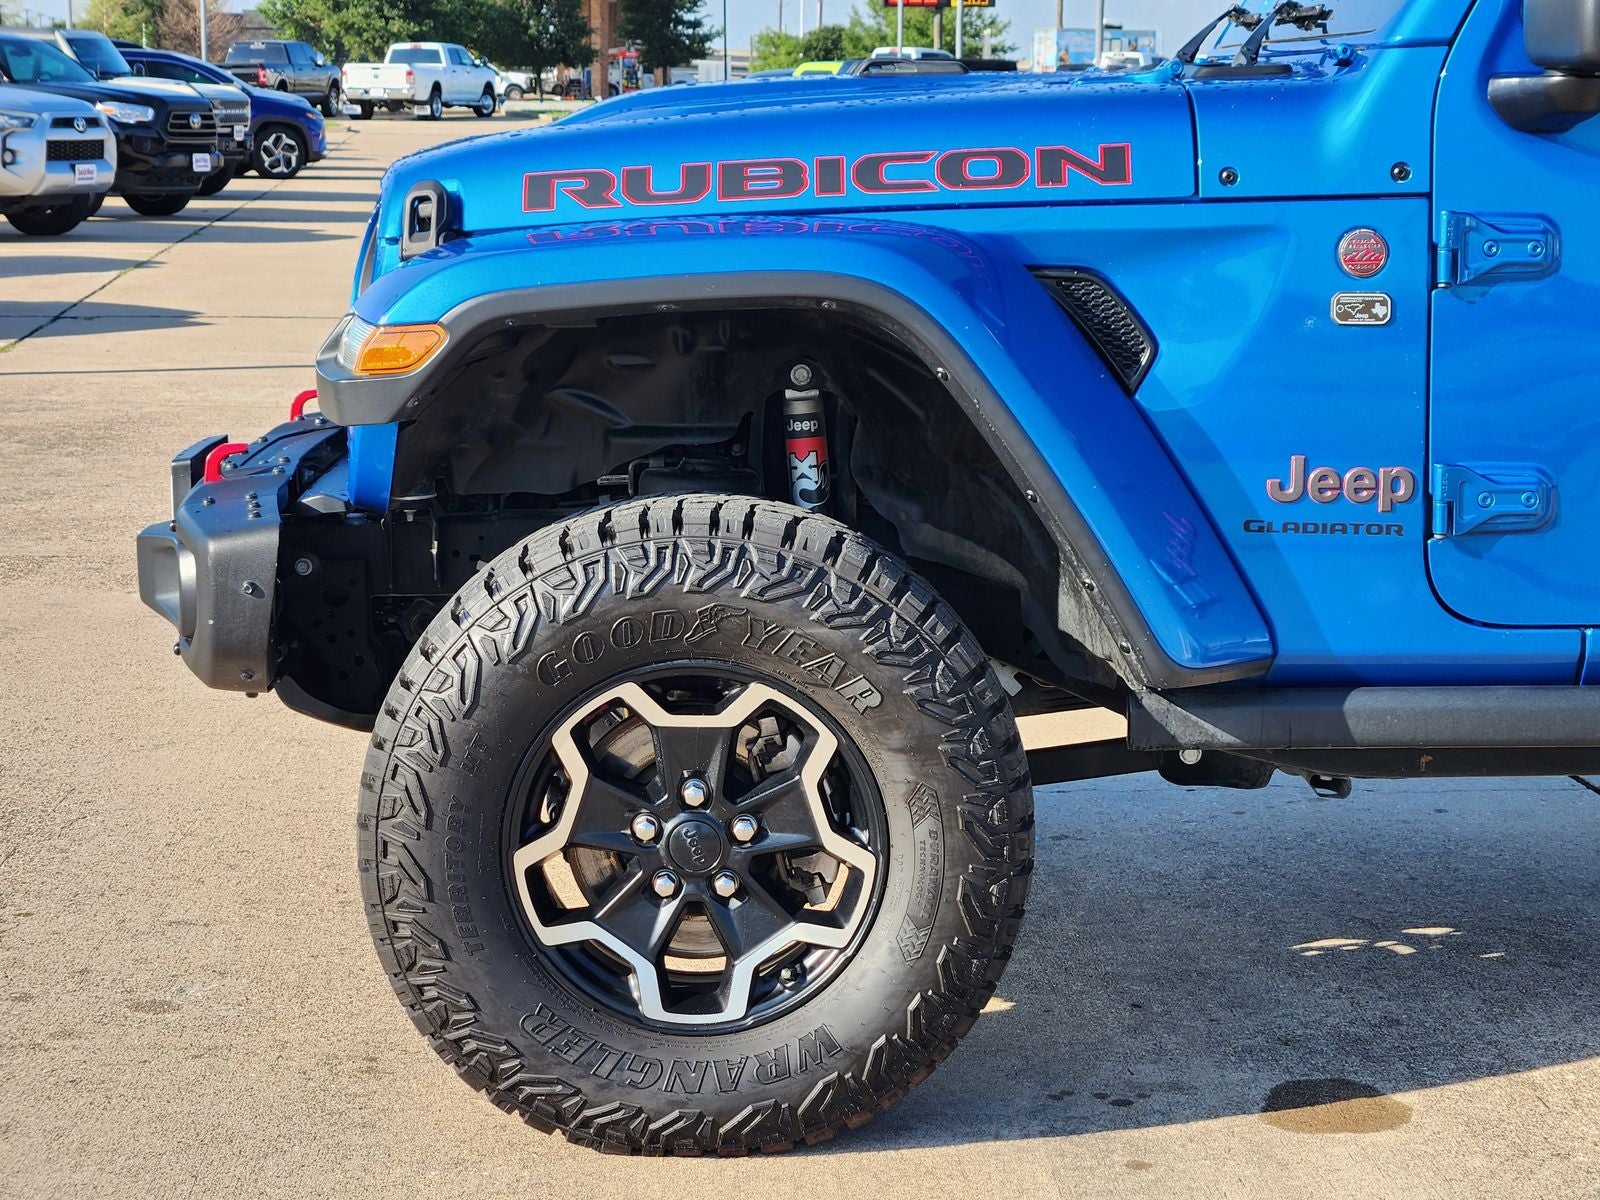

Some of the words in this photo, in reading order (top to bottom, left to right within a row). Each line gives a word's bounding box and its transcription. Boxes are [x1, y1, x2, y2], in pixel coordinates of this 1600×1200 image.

[522, 142, 1133, 213] RUBICON
[787, 419, 819, 432] Jeep
[1266, 454, 1415, 513] Jeep
[1243, 519, 1405, 537] GLADIATOR
[445, 794, 485, 956] TERRITORY
[682, 828, 705, 866] Jeep
[519, 1002, 844, 1094] WRANGLER
